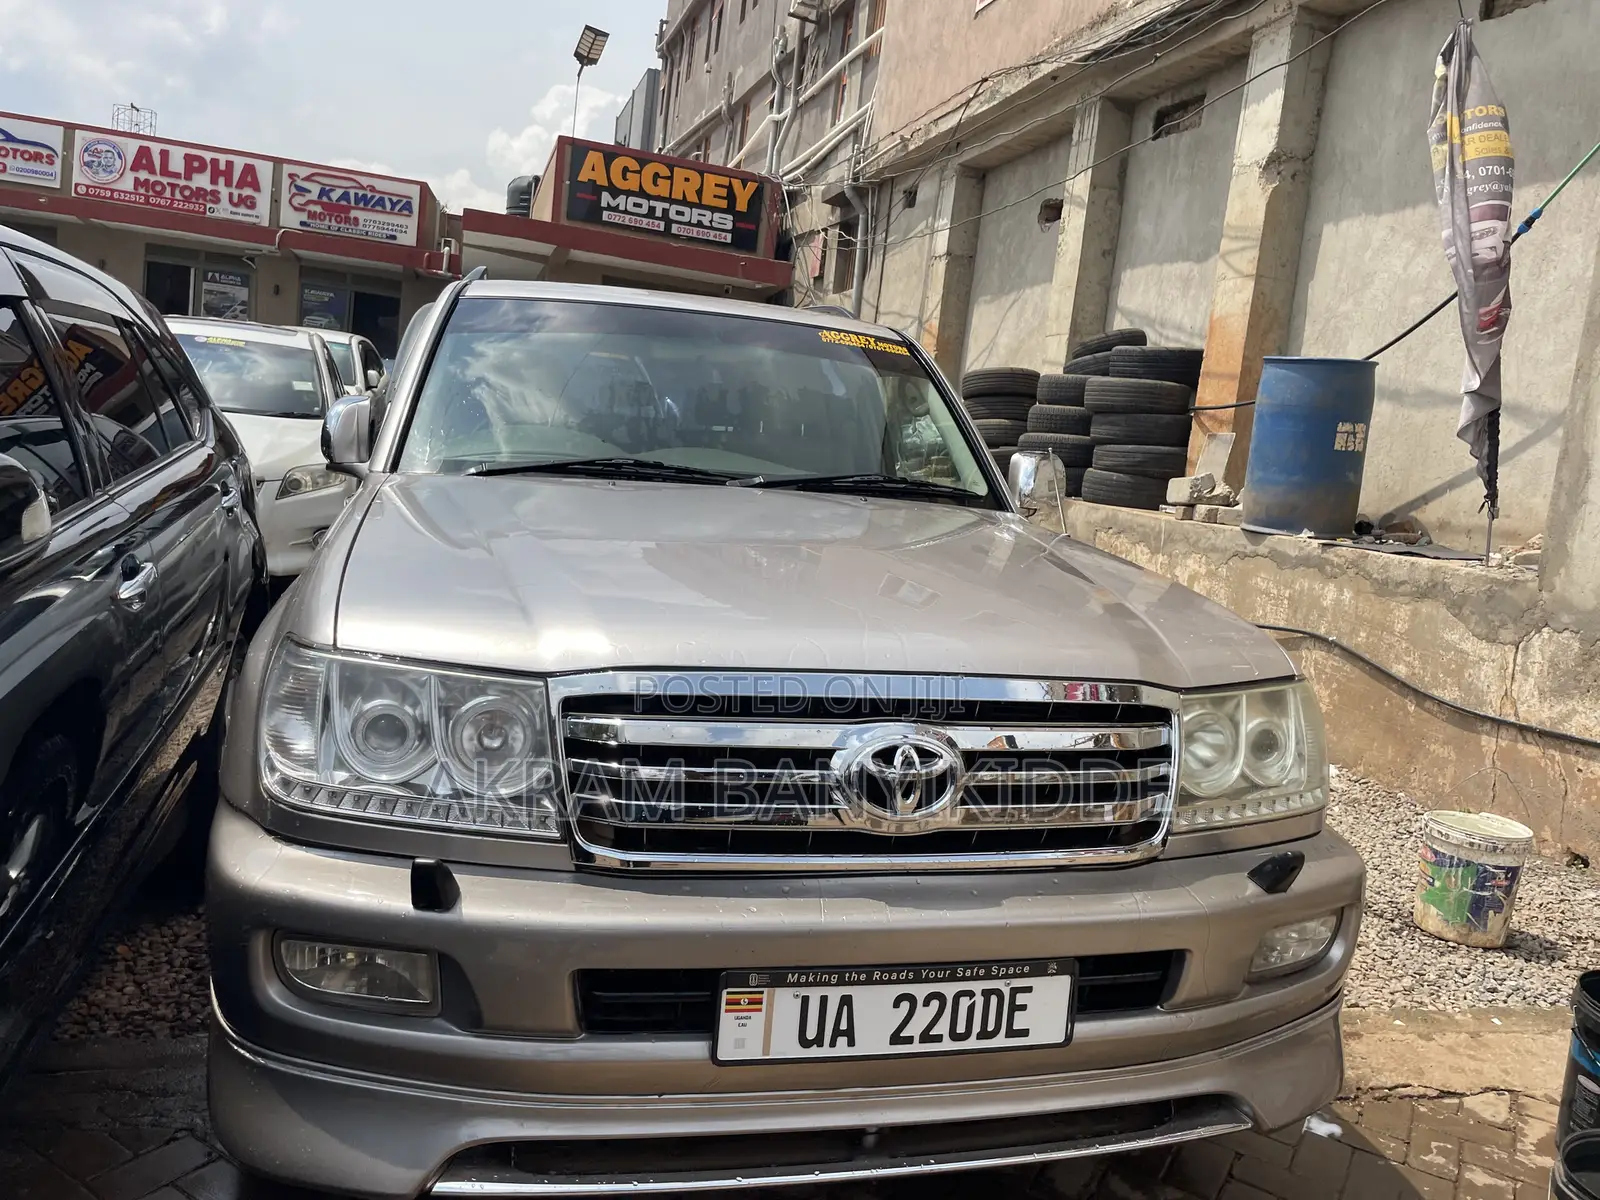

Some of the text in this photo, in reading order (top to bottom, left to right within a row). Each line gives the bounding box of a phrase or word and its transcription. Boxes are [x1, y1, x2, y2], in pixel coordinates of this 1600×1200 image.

[130, 145, 261, 193] ALPHA
[577, 150, 759, 213] AGGREY
[88, 187, 205, 212] 0759 632512 0767 222932
[133, 176, 258, 210] MOTORS UG
[317, 186, 414, 215] KAWAYA
[307, 209, 360, 227] MOTORS
[600, 191, 734, 230] MOTORS
[607, 213, 661, 230] 0772 690 454
[676, 226, 728, 242] 0701 690 454
[818, 329, 876, 347] AGGREY
[787, 964, 1032, 985] Making the Roads Your Safe Space
[798, 985, 1034, 1049] UA 220DE
